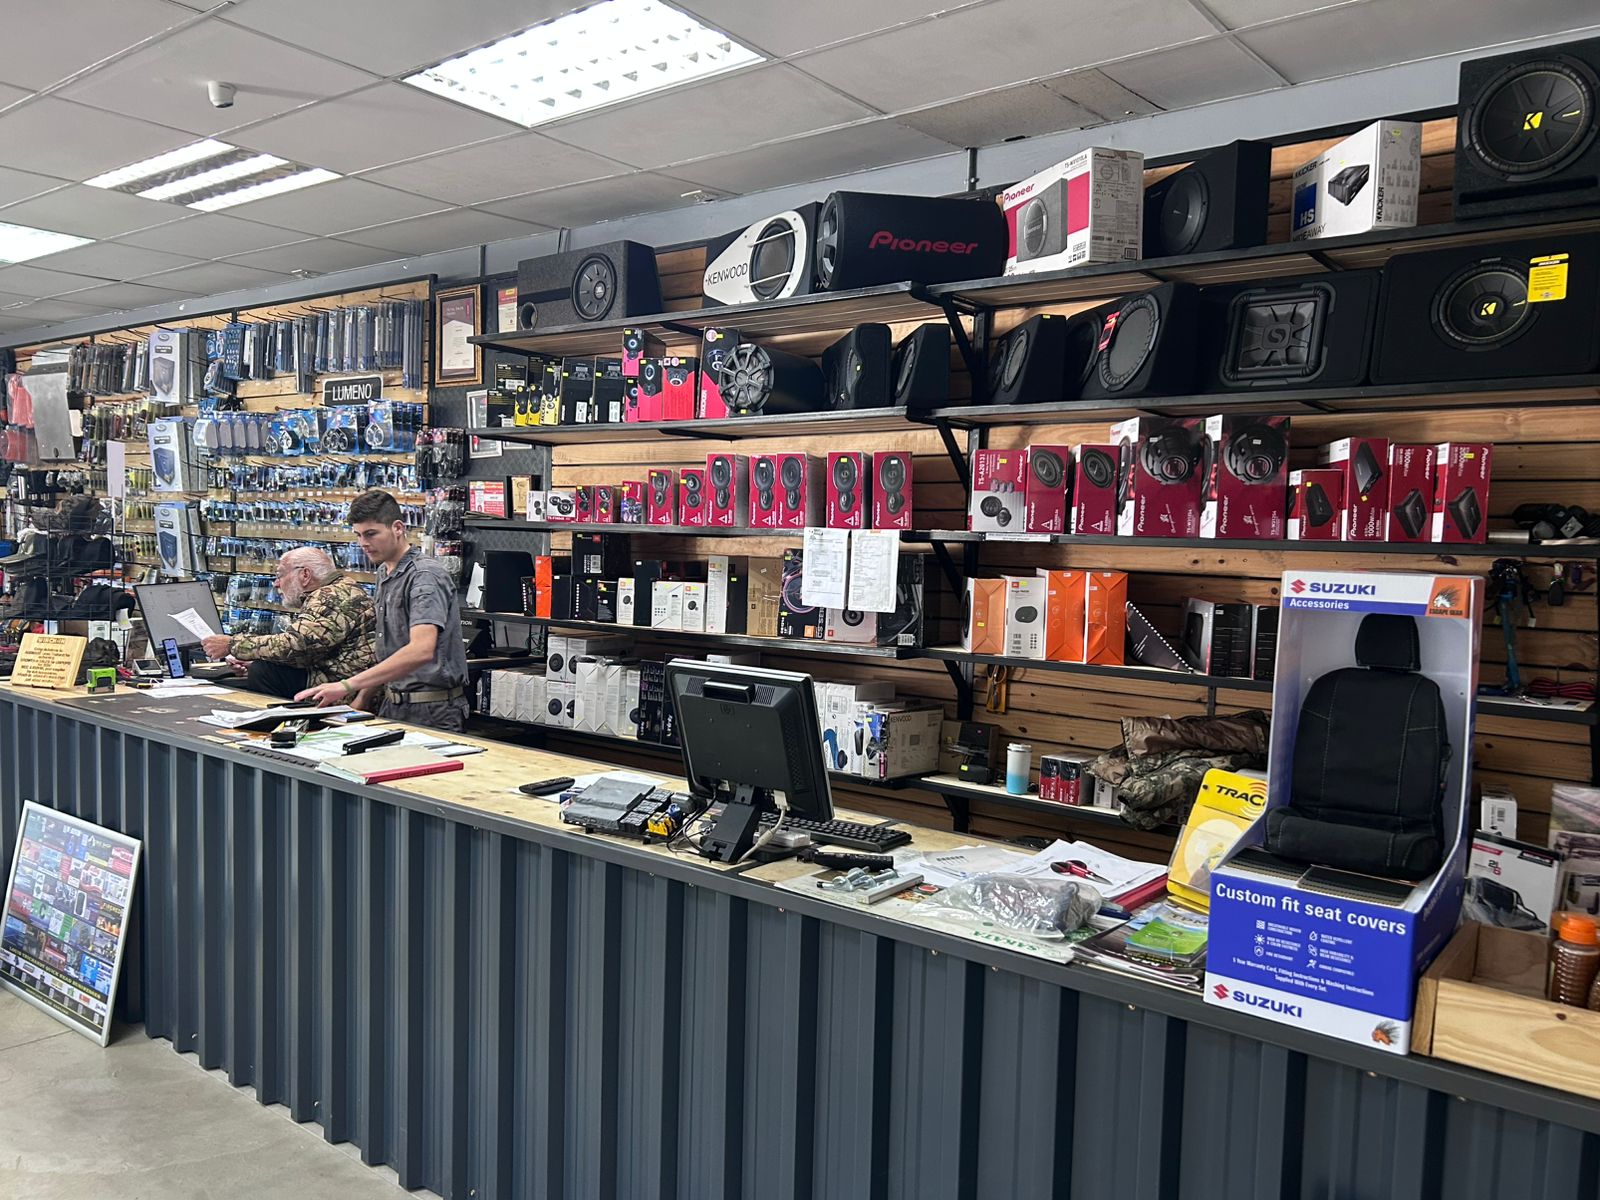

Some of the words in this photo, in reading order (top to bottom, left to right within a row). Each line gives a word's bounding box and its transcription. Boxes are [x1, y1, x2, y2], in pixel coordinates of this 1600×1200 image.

[1003, 184, 1036, 202] Pioneer
[1376, 187, 1385, 217] KICKER
[1300, 208, 1316, 227] HS
[869, 231, 978, 255] Pioneer
[706, 262, 748, 286] KENWOOD
[332, 383, 372, 401] LUMENO
[1016, 454, 1024, 483] Pioneer
[1425, 448, 1433, 480] Pioneer
[1480, 447, 1489, 480] Pioneer
[1138, 495, 1146, 532] Pioneer
[1220, 496, 1229, 534] Pioneer
[1350, 504, 1358, 537] Pioneer
[1309, 582, 1376, 596] SUZUKI
[1289, 598, 1350, 610] Accessories
[1216, 785, 1267, 807] TRAC
[1216, 883, 1276, 908] Custom
[1281, 897, 1300, 913] fit
[1304, 904, 1342, 922] seat
[1347, 912, 1407, 936] covers
[972, 931, 1040, 951] SAKATA
[1246, 960, 1266, 973] Warranty
[1278, 967, 1292, 978] Fitting
[1292, 970, 1320, 984] Instructions
[1325, 979, 1345, 990] Washing
[1345, 983, 1375, 997] Instructions
[1275, 974, 1294, 985] Supplied
[1294, 978, 1305, 987] With
[1305, 980, 1318, 992] Every
[1233, 991, 1303, 1018] SUZUKI
